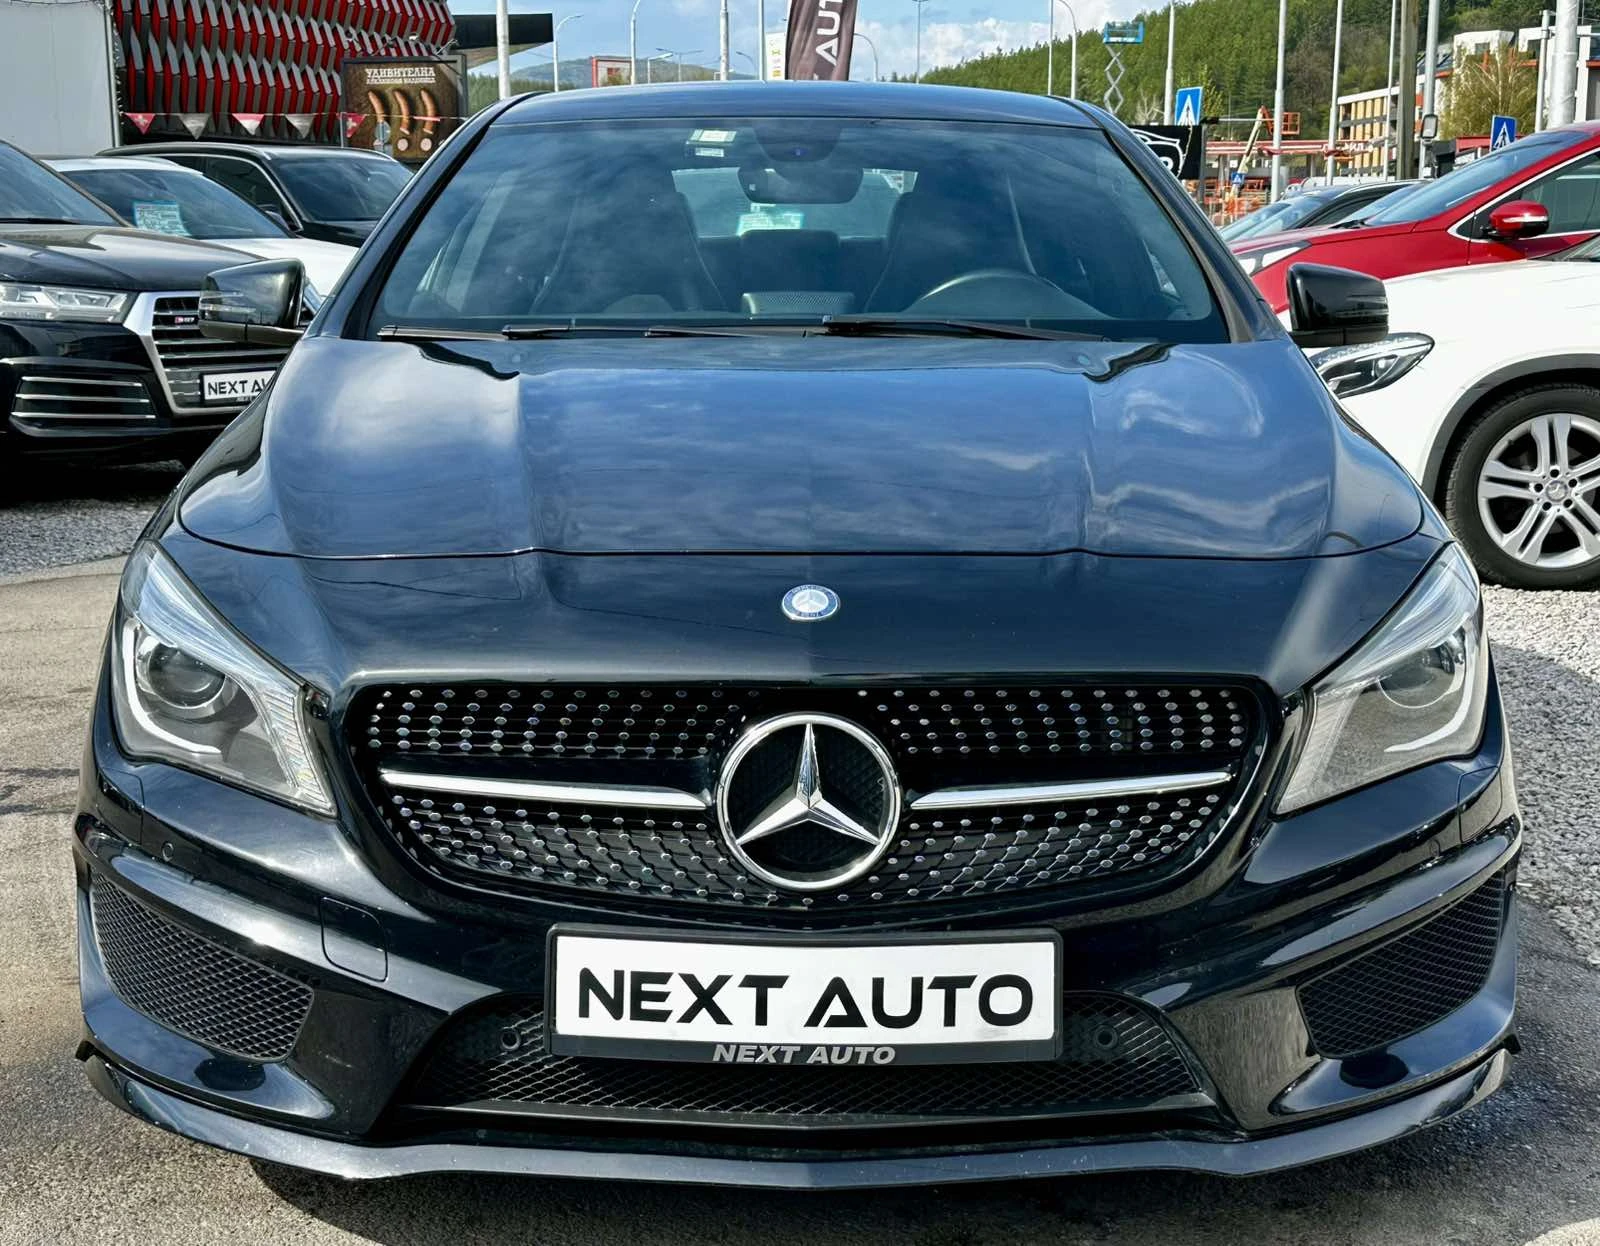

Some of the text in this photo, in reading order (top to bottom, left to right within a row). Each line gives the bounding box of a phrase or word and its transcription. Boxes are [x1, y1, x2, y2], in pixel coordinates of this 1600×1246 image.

[207, 379, 248, 396] NEXT
[578, 967, 1033, 1028] NEXT AUTO
[712, 1044, 896, 1065] NEXT AUTO
